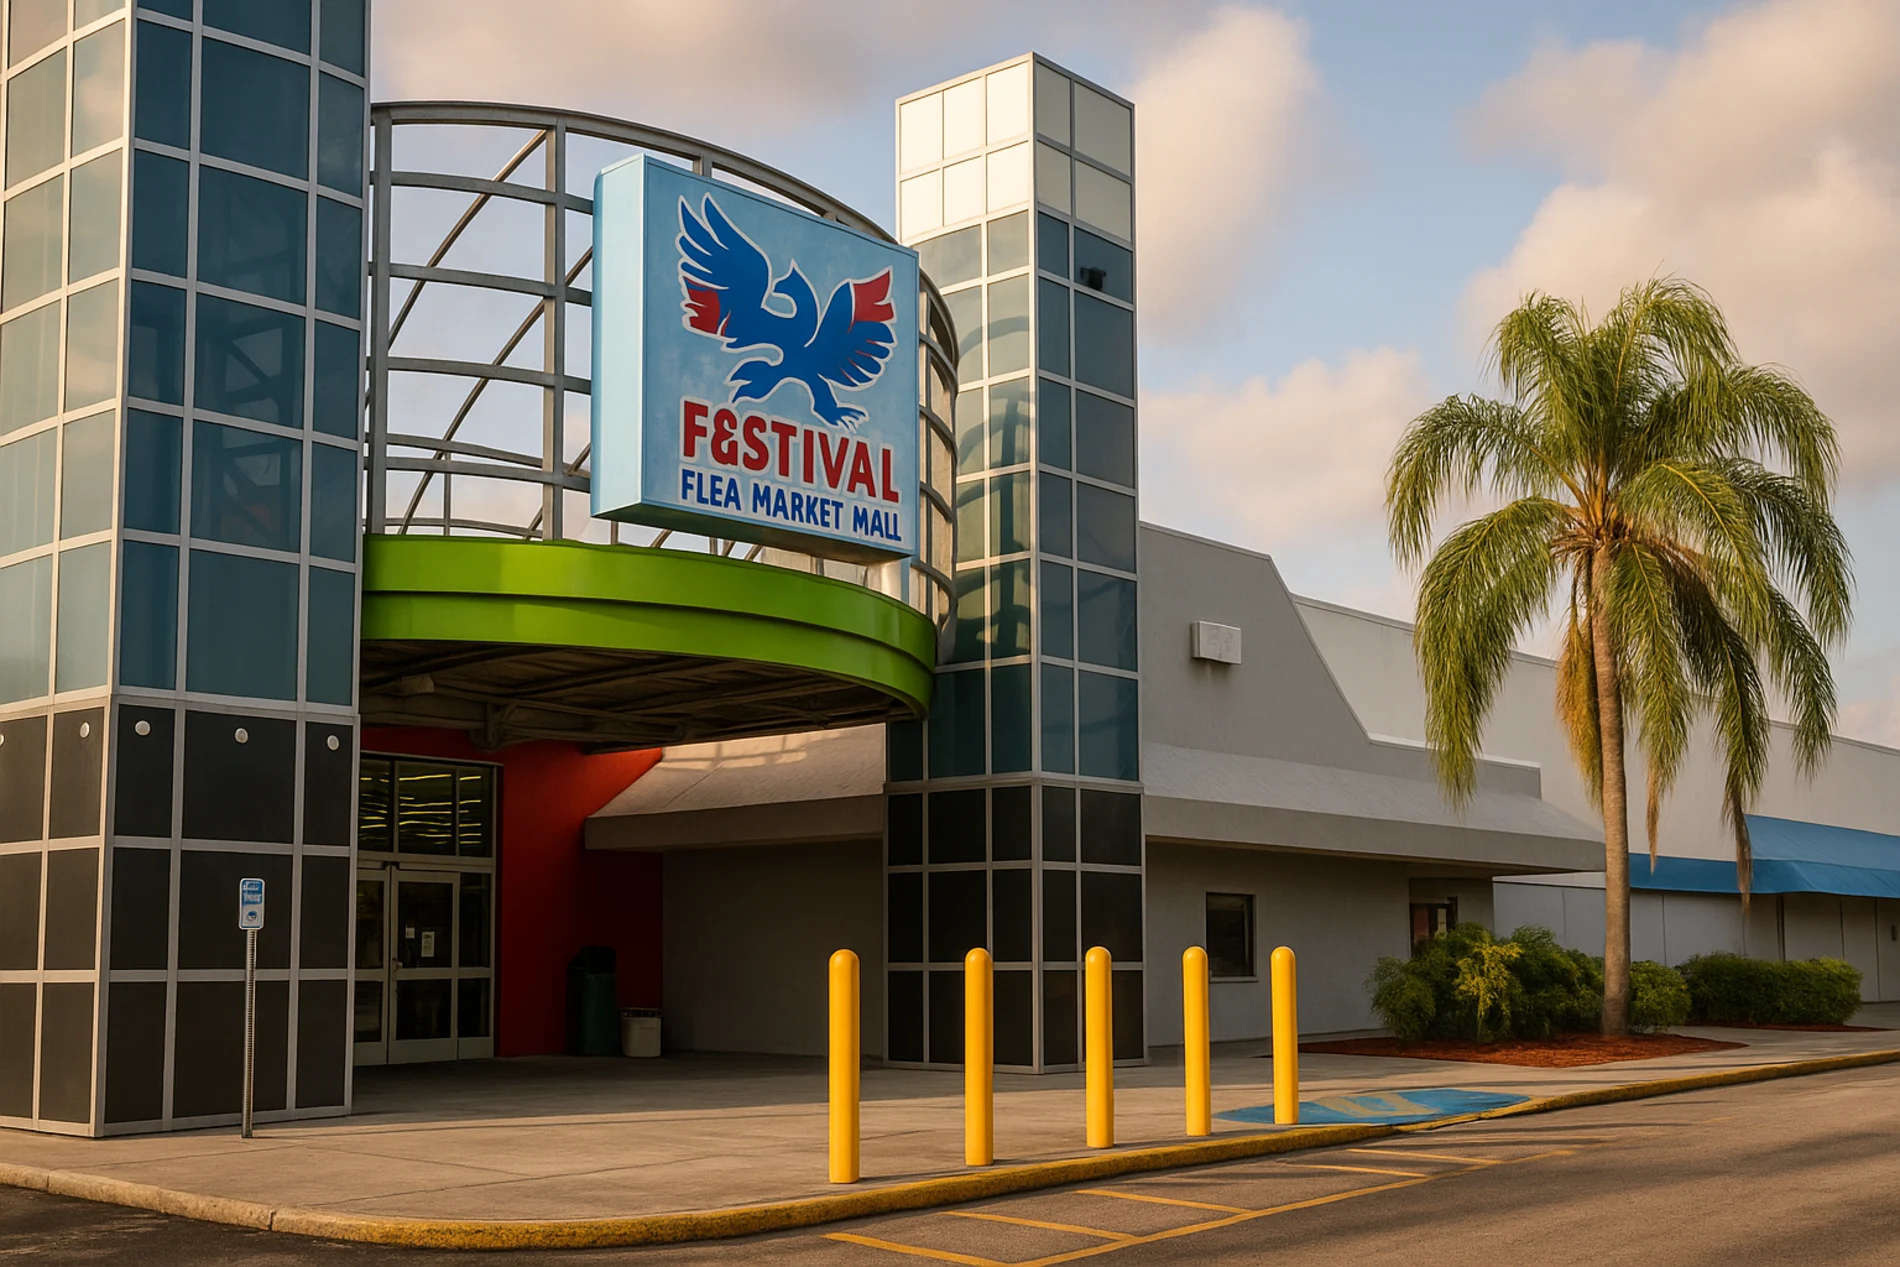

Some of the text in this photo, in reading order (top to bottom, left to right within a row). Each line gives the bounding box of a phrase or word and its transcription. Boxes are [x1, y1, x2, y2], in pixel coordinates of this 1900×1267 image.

[683, 469, 901, 541] FLEA MARKET MALL
